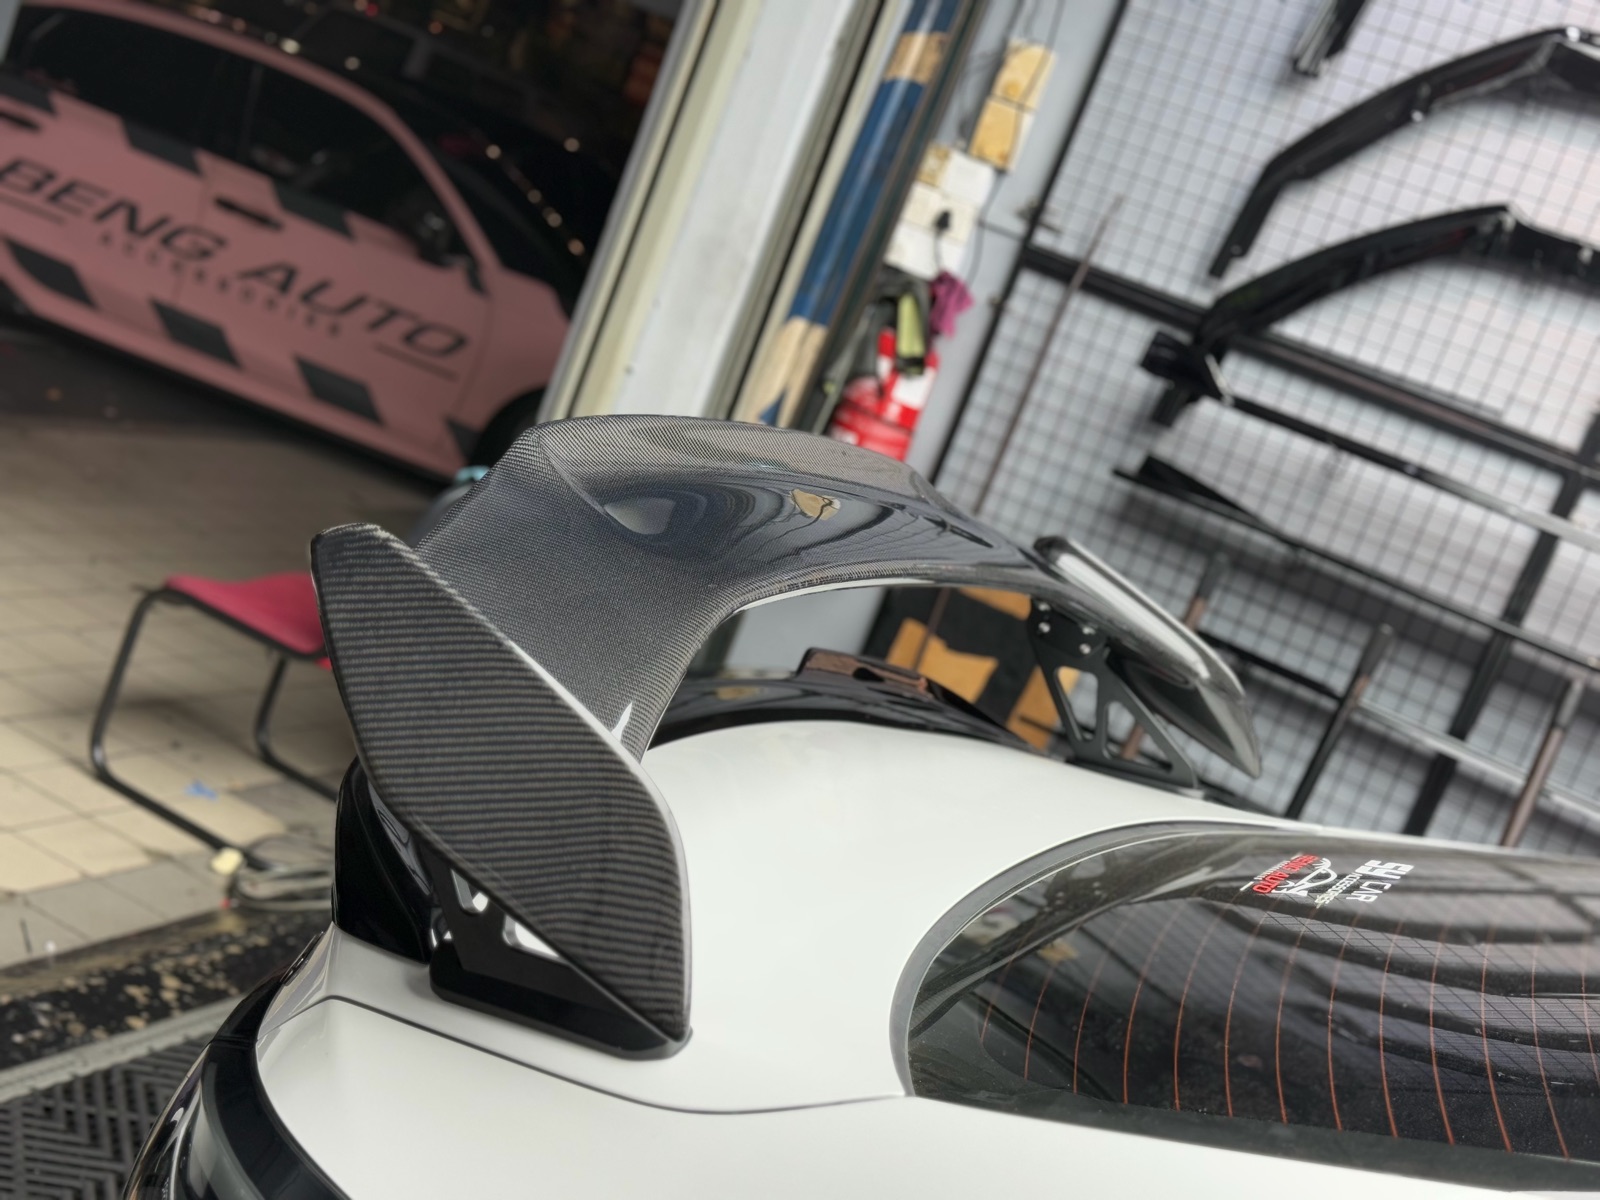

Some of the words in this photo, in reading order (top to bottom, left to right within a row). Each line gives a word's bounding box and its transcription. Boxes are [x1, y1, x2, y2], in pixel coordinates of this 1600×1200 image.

[0, 157, 227, 261] BENG
[237, 262, 467, 358] AUTO
[1252, 873, 1290, 894] AUTO
[1346, 881, 1391, 902] CAR
